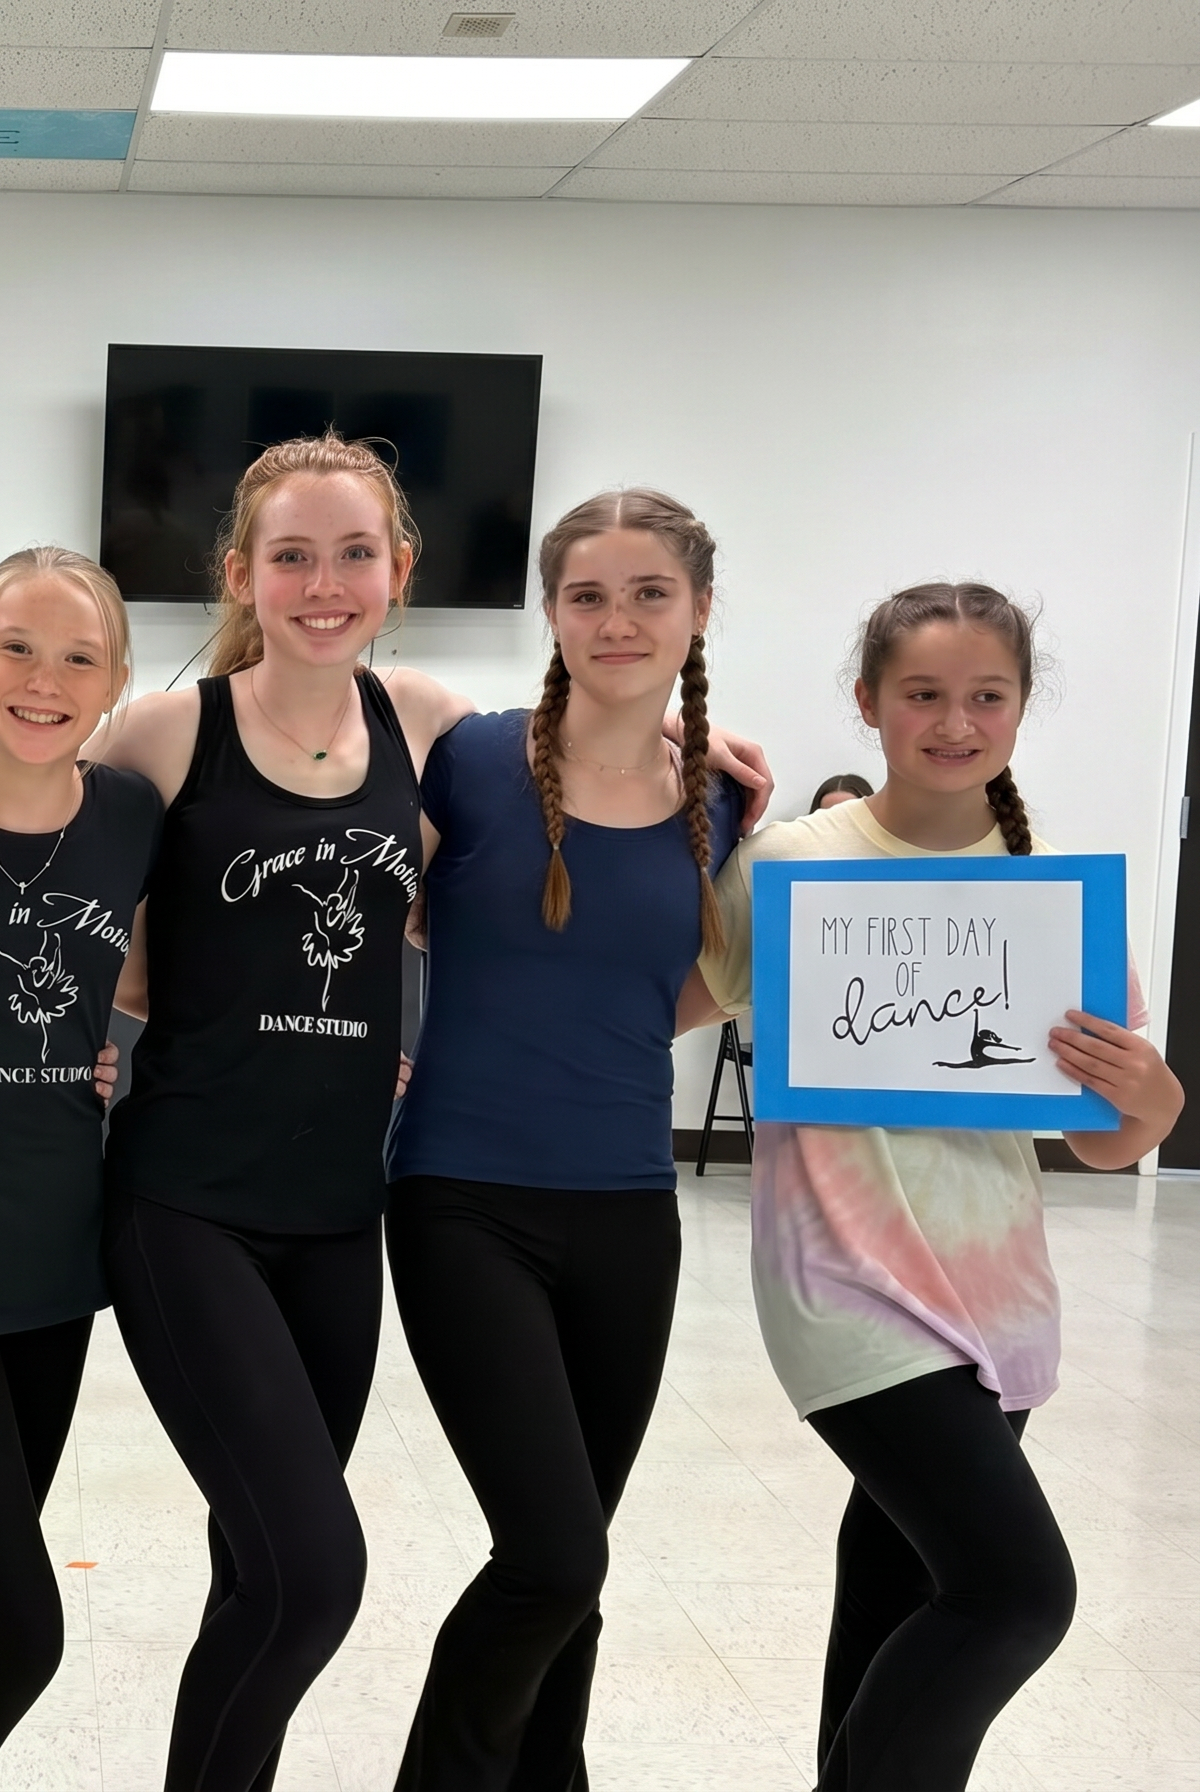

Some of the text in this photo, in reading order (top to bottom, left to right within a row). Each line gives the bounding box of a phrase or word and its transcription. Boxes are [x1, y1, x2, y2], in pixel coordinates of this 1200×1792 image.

[221, 846, 306, 903] Grace
[315, 837, 336, 862] in
[8, 902, 31, 926] in
[36, 892, 130, 958] Motio
[821, 917, 996, 957] MY FIRST DAY
[832, 939, 1010, 1046] dance!
[896, 962, 922, 997] OF
[258, 1014, 368, 1038] DANCE STUDIO
[40, 1066, 92, 1083] STUDIO
